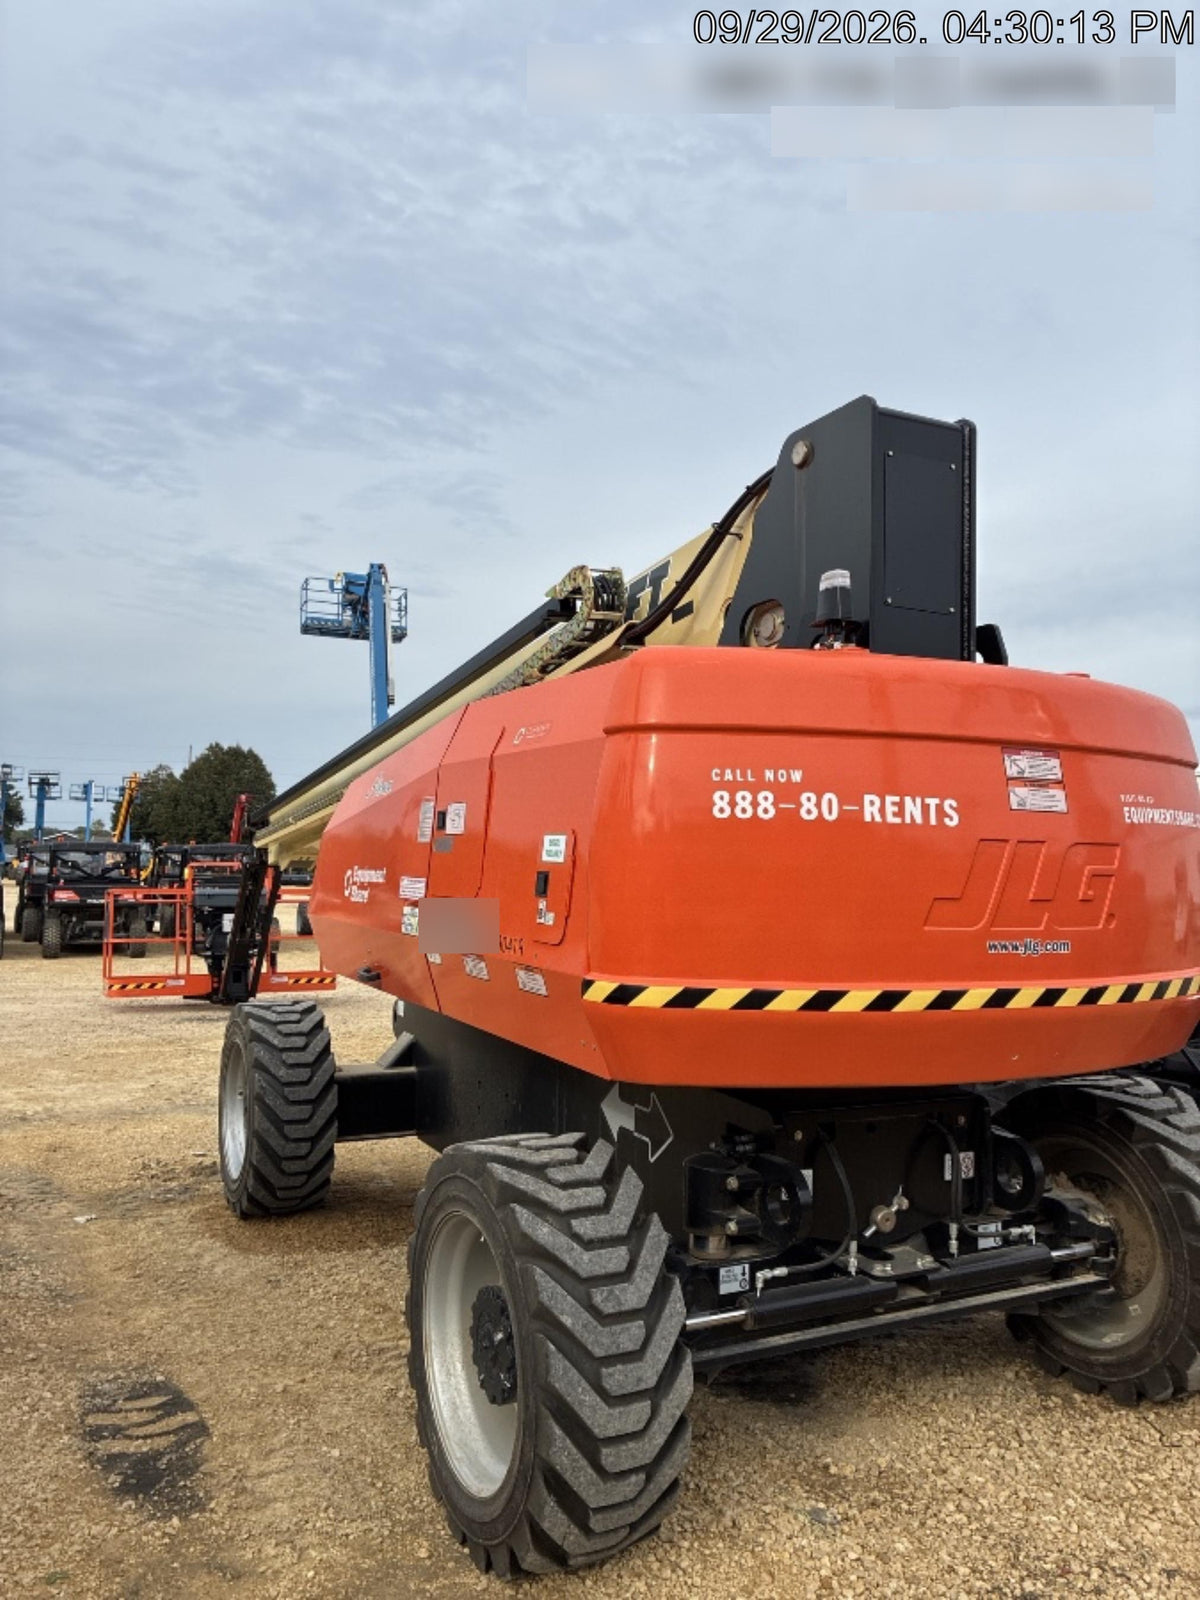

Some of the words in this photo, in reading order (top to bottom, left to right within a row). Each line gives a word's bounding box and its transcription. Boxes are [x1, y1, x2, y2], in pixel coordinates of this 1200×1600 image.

[711, 768, 756, 782] CALL
[764, 769, 803, 783] NOW
[712, 790, 960, 827] 888-80-RENTS
[923, 839, 1121, 930] JLG
[987, 938, 1071, 956] www.jlg.com
